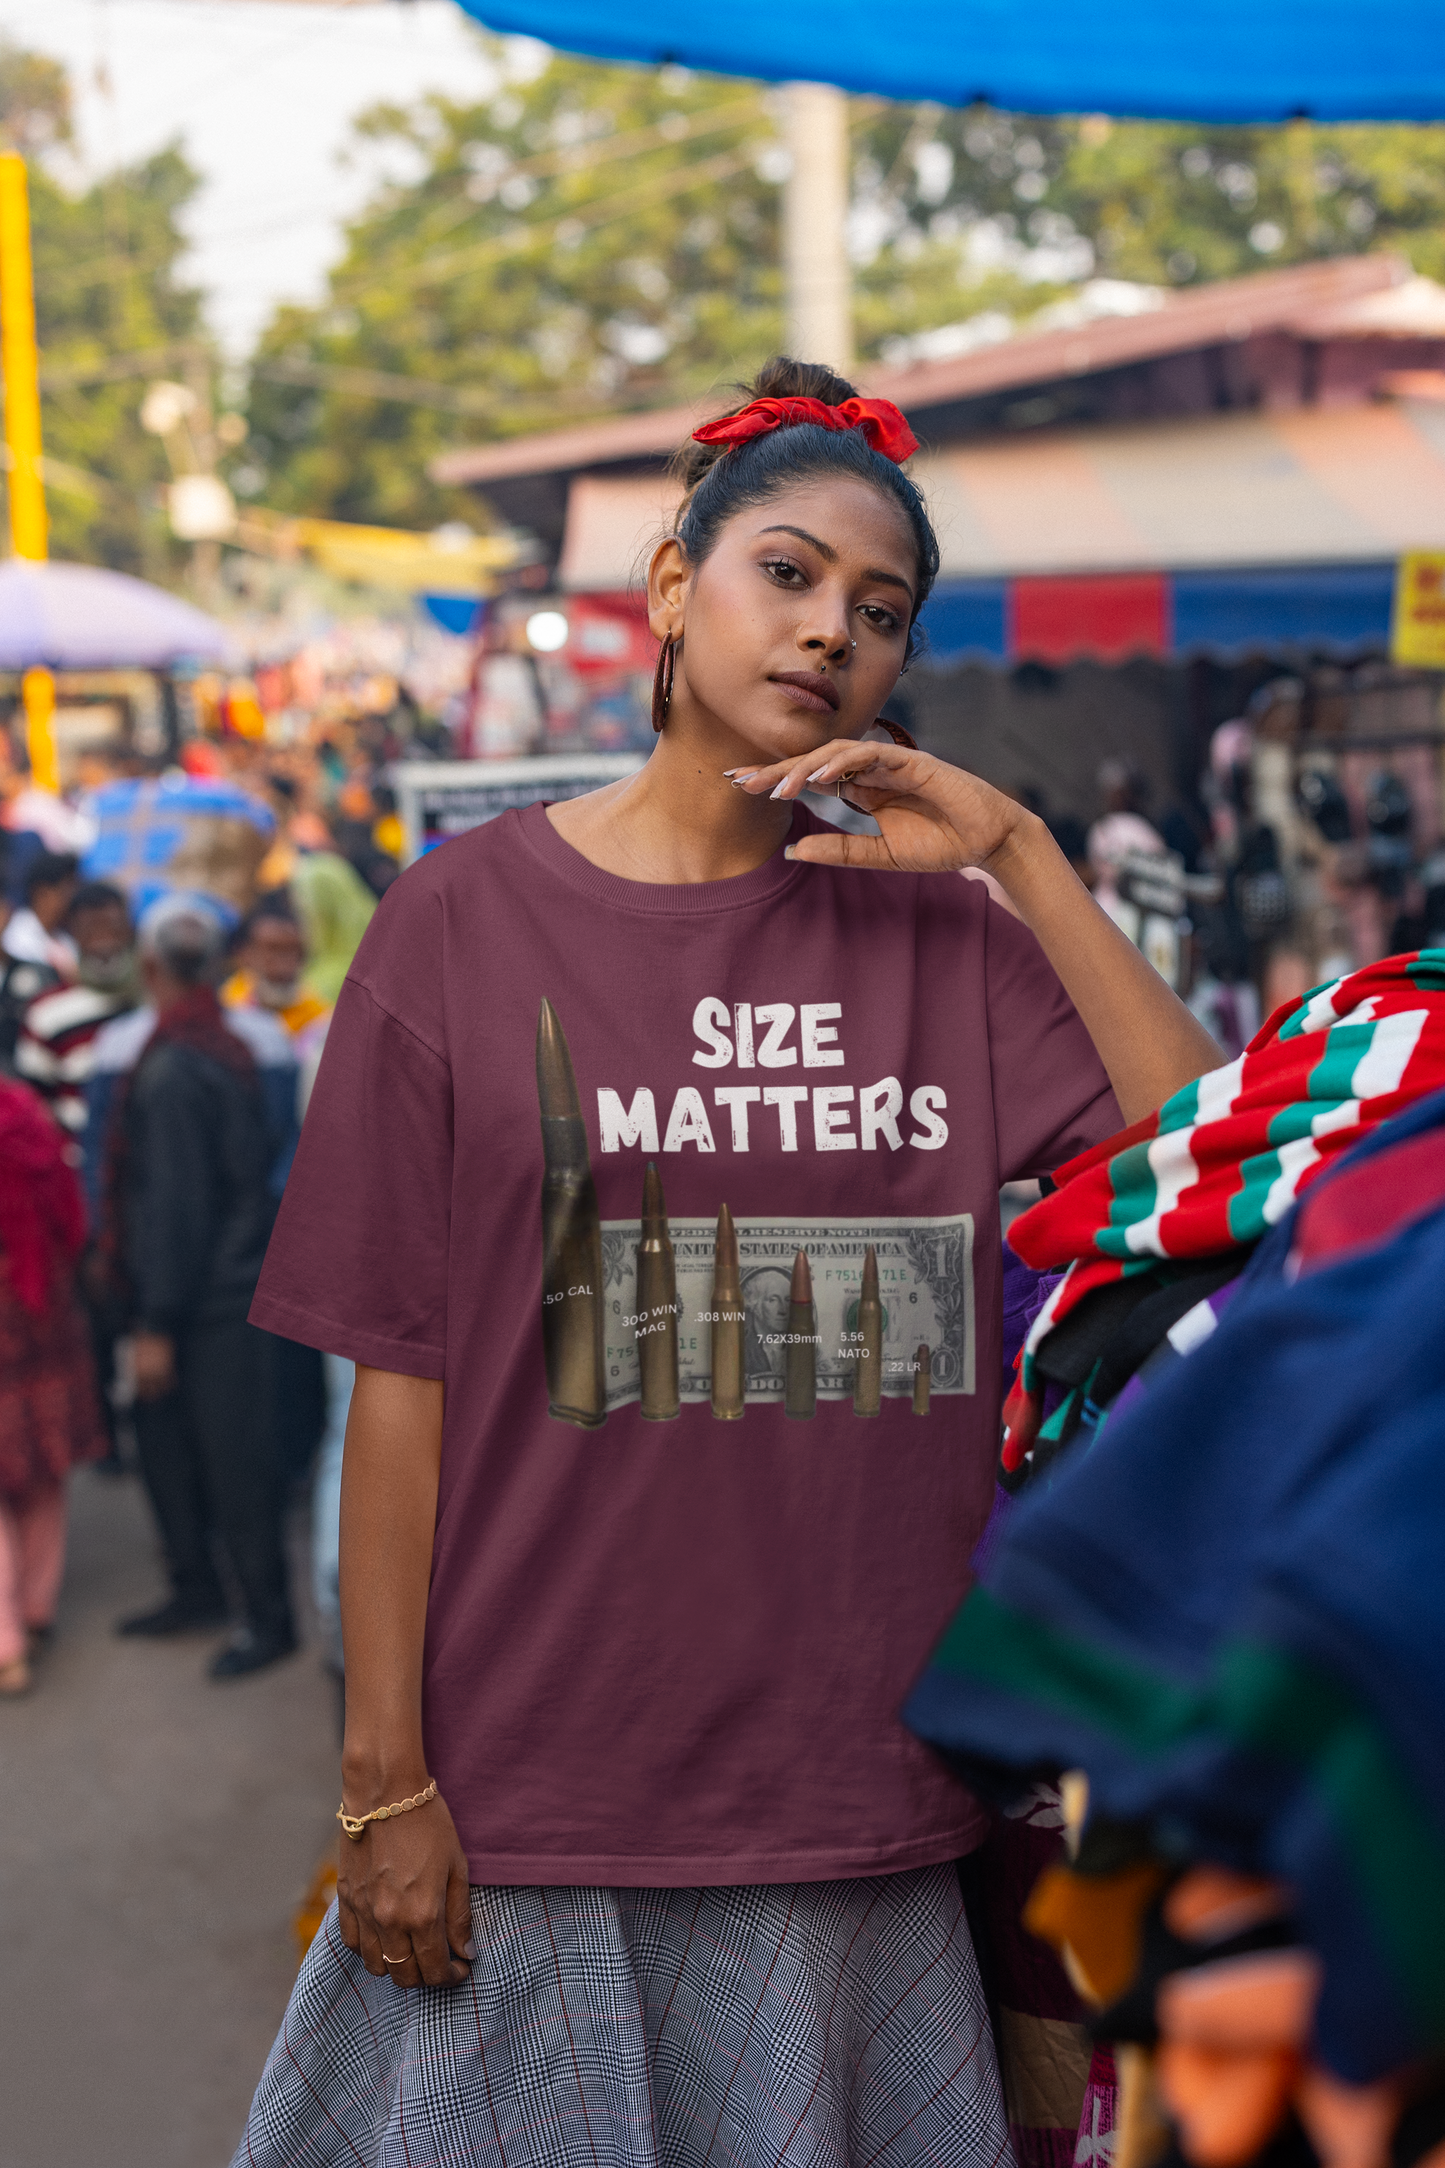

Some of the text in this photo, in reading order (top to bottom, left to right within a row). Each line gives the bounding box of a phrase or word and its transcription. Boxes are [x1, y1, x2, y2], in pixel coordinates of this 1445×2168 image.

[692, 996, 845, 1068] SIZE
[597, 1076, 949, 1152] MATTERS
[669, 1229, 868, 1237] FEDEL RESERVE NOTE
[673, 1243, 717, 1255] UNIT
[739, 1242, 803, 1255] STATES
[805, 1242, 826, 1255] OF
[543, 1285, 593, 1304] .50 CAL
[622, 1304, 677, 1327] 300 WIN
[694, 1311, 746, 1322] .308 WIN
[635, 1321, 666, 1339] MAG
[757, 1334, 823, 1344] 7.62X39mm
[840, 1332, 865, 1342] 5.56
[838, 1348, 870, 1359] NATO
[888, 1362, 921, 1372] .22 LR
[749, 1378, 844, 1390] DOAR
